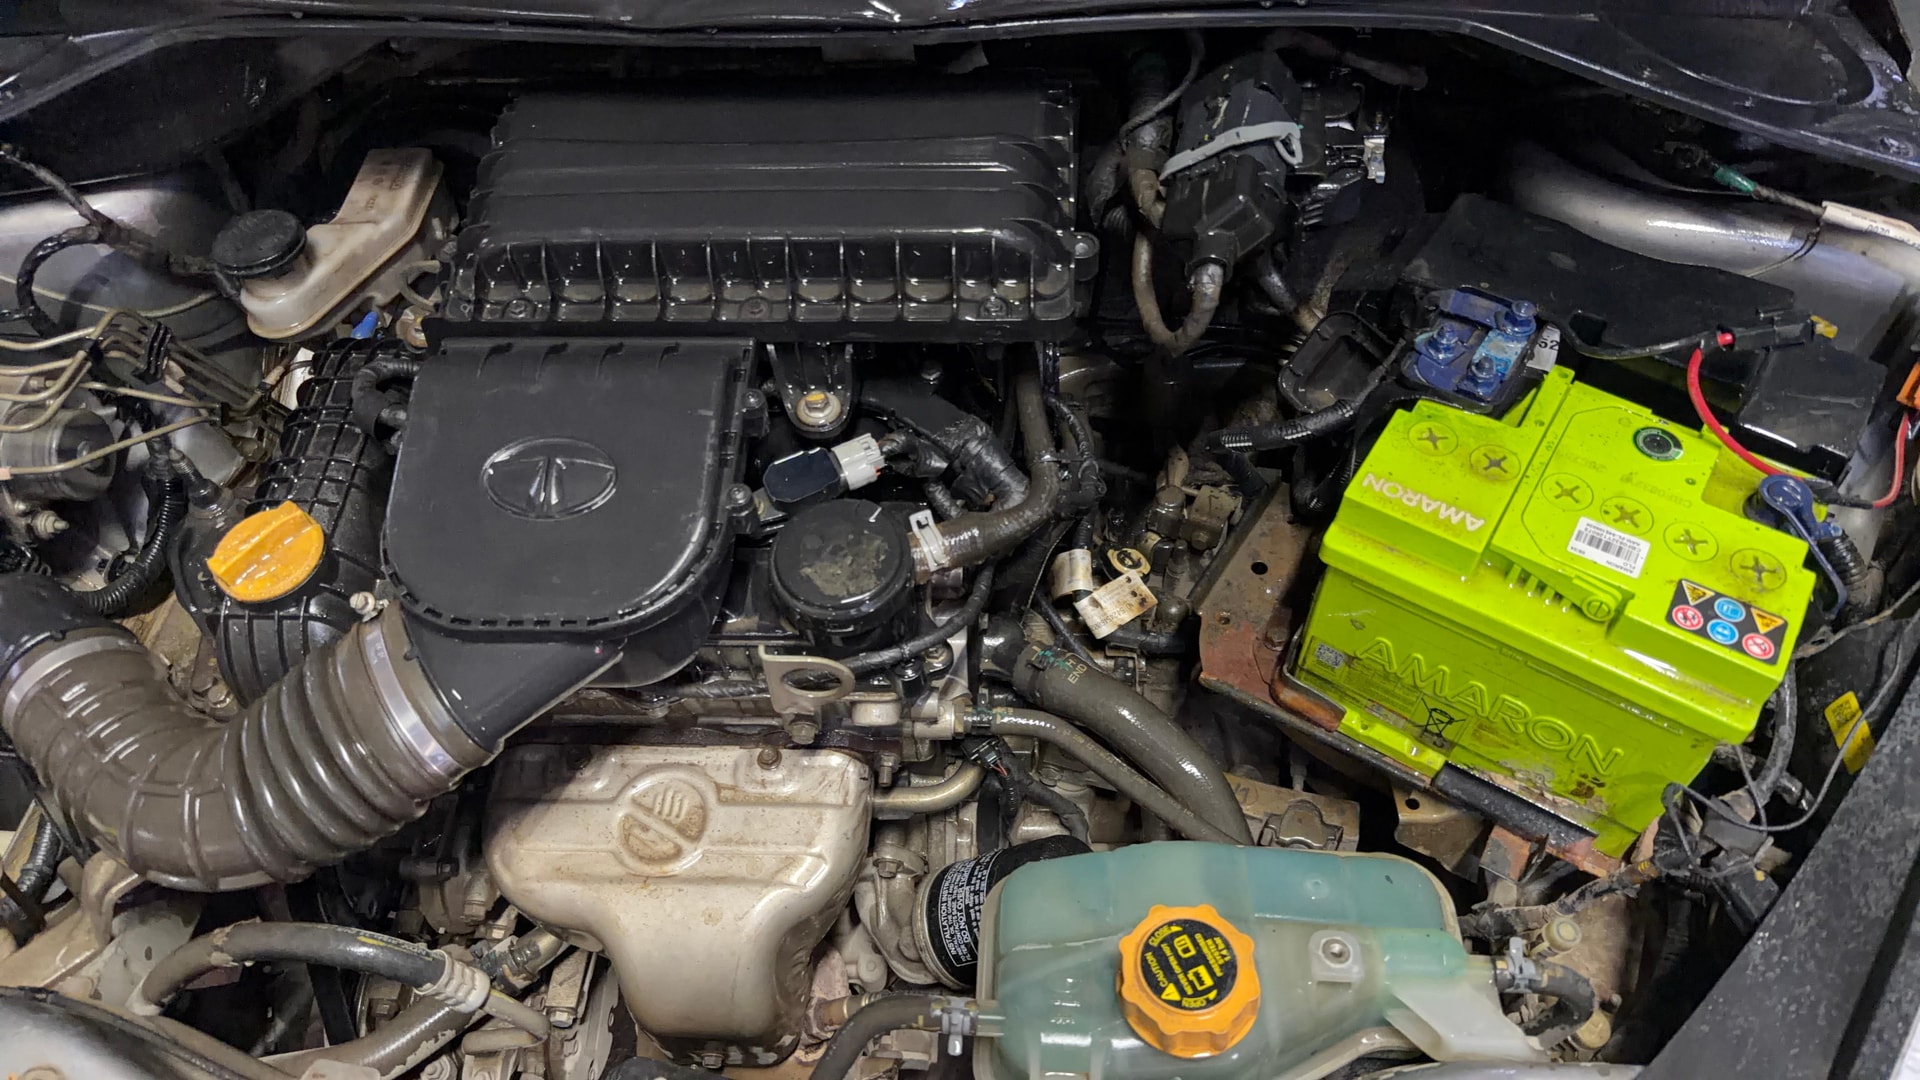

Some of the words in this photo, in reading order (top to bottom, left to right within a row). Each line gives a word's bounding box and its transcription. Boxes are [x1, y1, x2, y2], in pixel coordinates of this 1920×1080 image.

[1362, 473, 1485, 531] AMARON
[1067, 663, 1087, 684] END
[1357, 637, 1625, 776] AMARON
[957, 888, 965, 910] OVER
[941, 902, 957, 955] INSTALLATION
[958, 911, 967, 929] NOT
[961, 930, 970, 943] DO
[1144, 951, 1168, 987] CAUTION
[1168, 955, 1182, 974] OPEN
